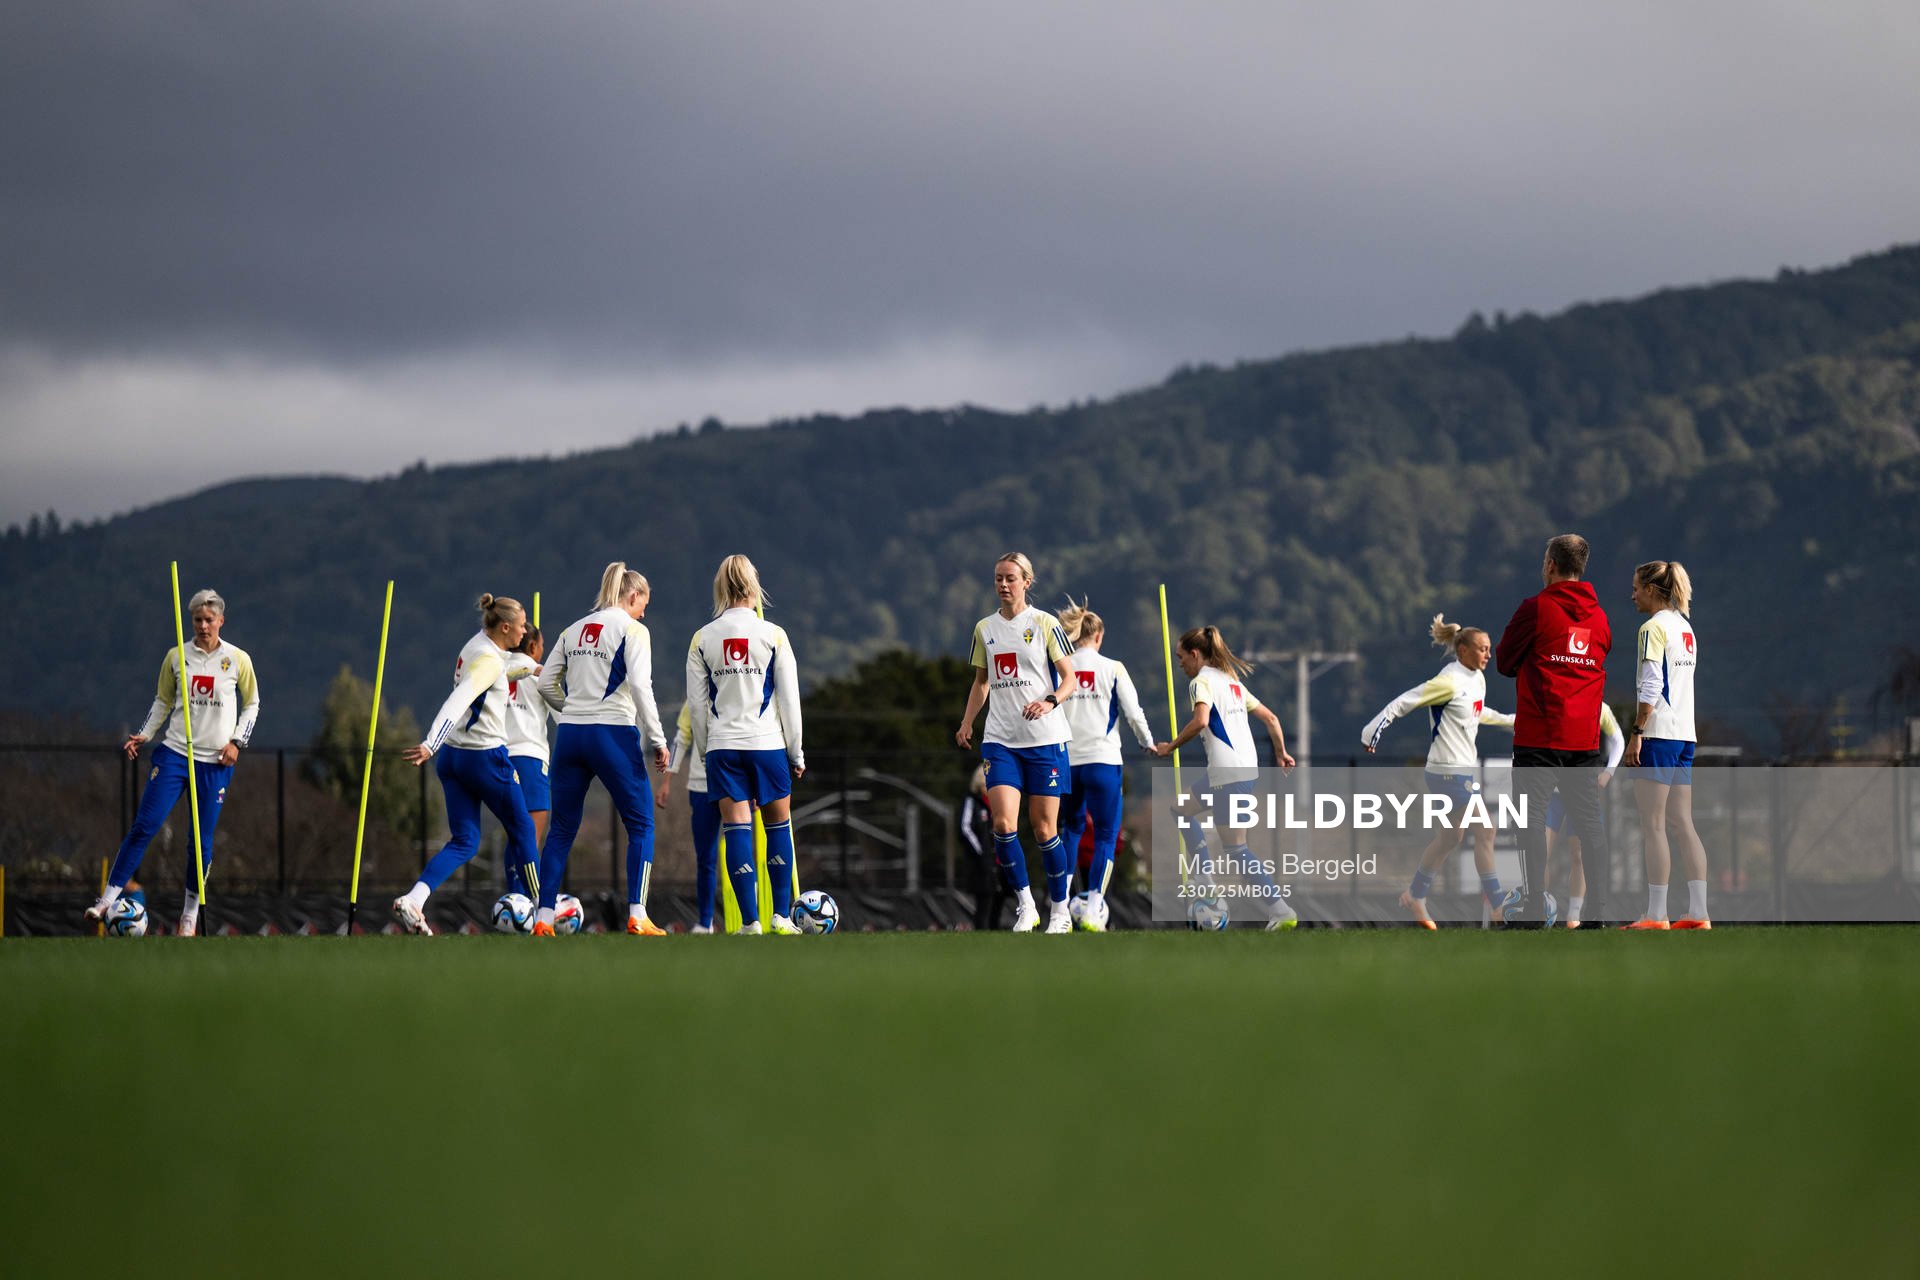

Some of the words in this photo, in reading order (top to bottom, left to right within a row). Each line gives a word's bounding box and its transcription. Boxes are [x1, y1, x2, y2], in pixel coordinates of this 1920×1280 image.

[568, 649, 592, 657] SENSKA
[593, 651, 608, 660] SPEL
[1550, 654, 1584, 665] SVENSKA
[745, 667, 762, 675] SPEL
